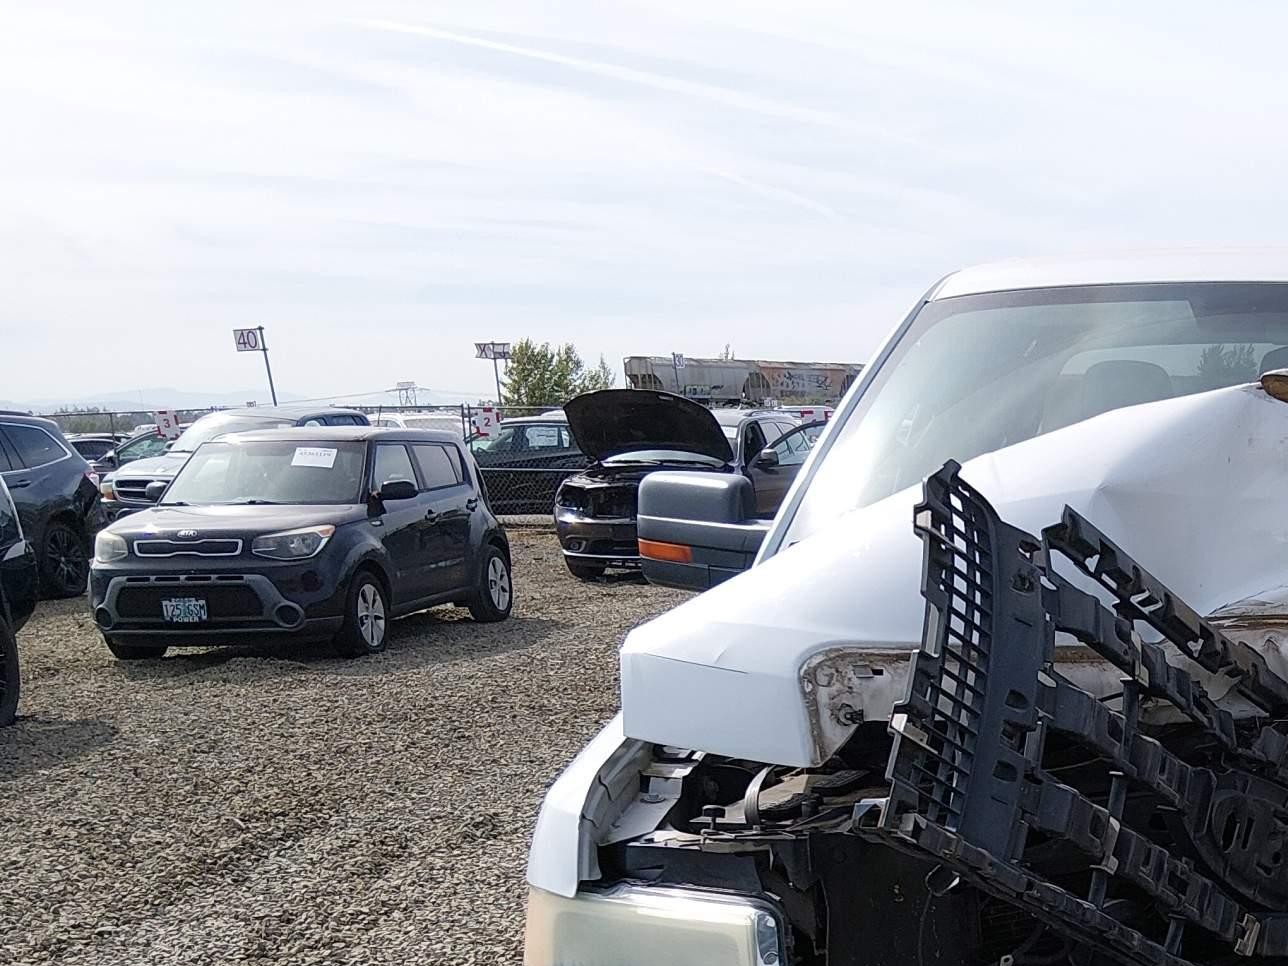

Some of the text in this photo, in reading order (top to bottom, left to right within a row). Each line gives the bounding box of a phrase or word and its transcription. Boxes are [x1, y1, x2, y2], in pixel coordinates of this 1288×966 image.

[238, 330, 257, 348] 40
[163, 418, 171, 428] 3
[484, 417, 491, 427] 2
